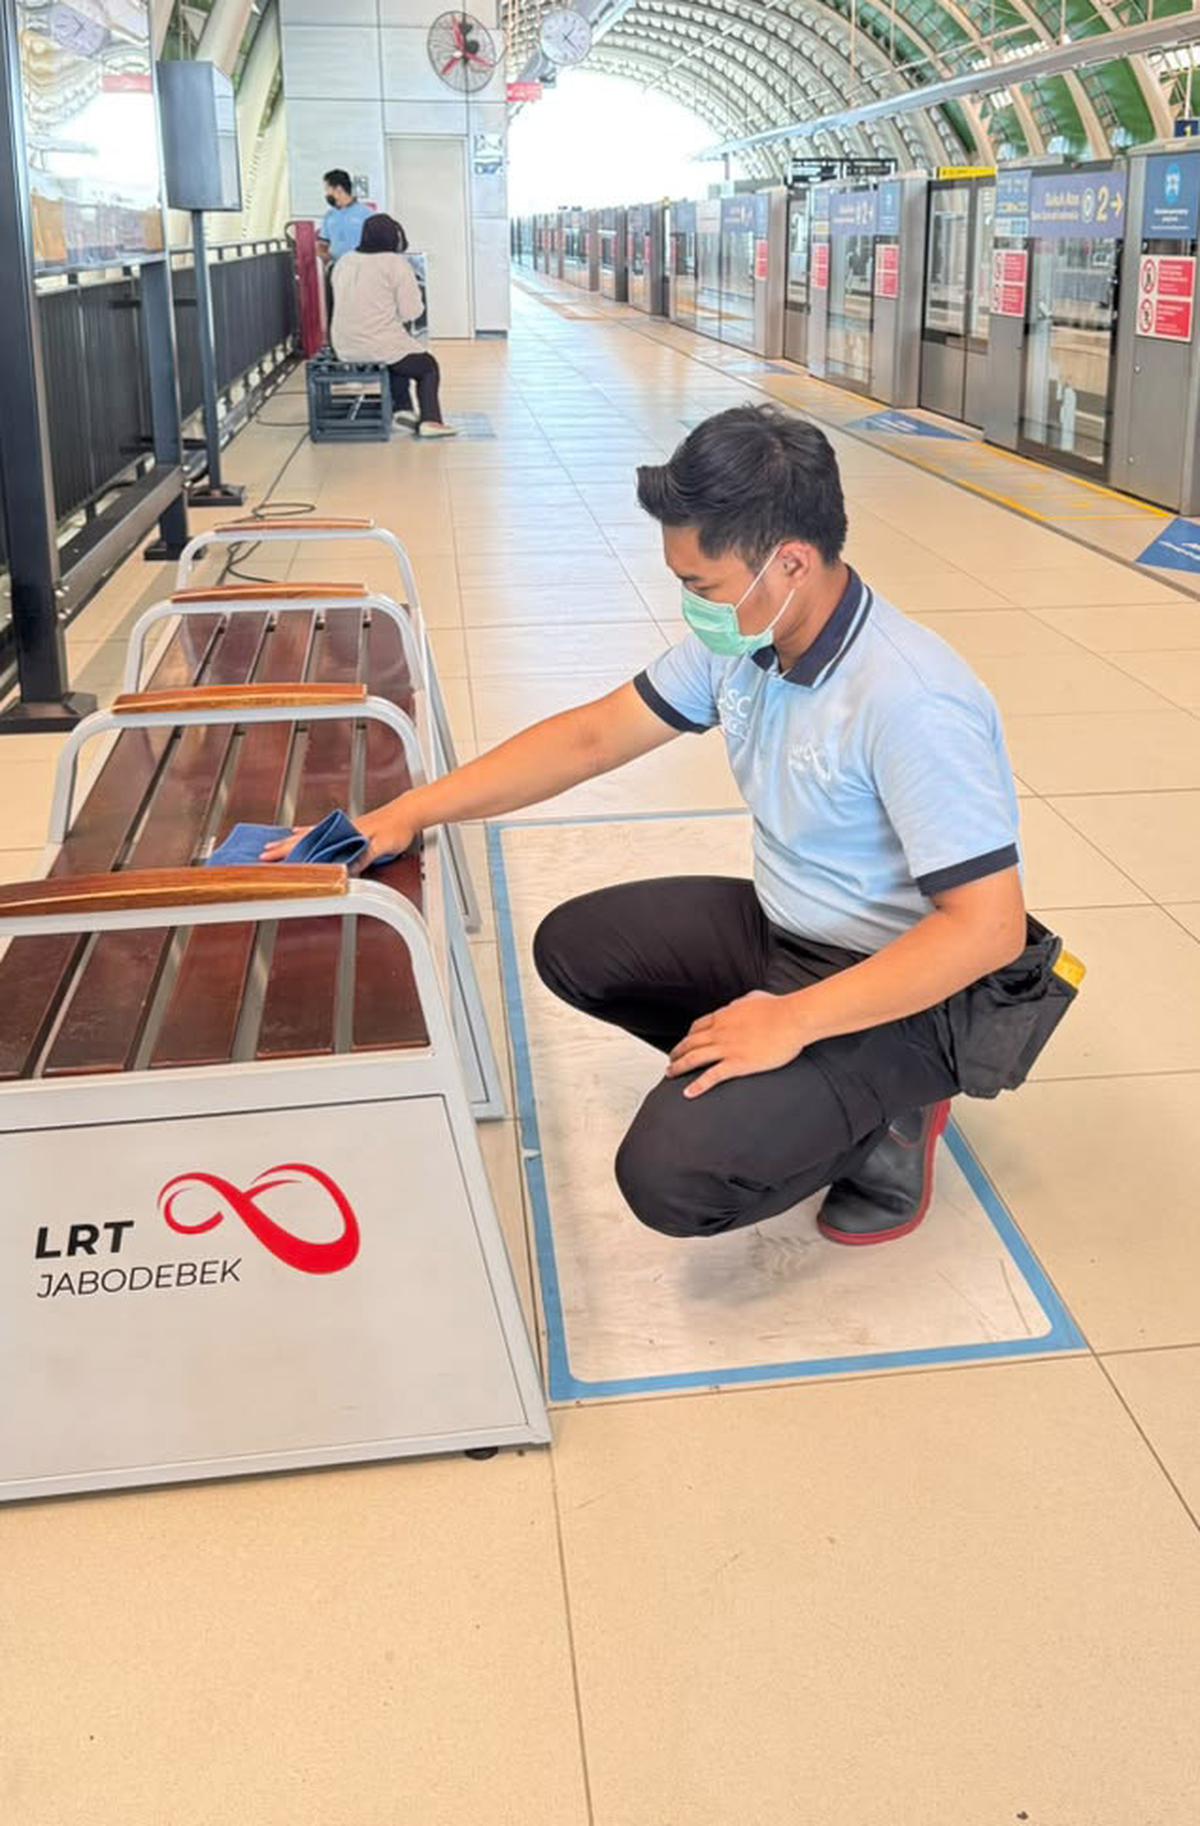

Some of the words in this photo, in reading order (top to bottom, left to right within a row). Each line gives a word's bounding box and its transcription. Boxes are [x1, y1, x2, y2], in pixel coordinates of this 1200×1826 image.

[1096, 186, 1109, 222] 2
[35, 1220, 134, 1259] LRT
[36, 1258, 242, 1299] JABODEBEK
